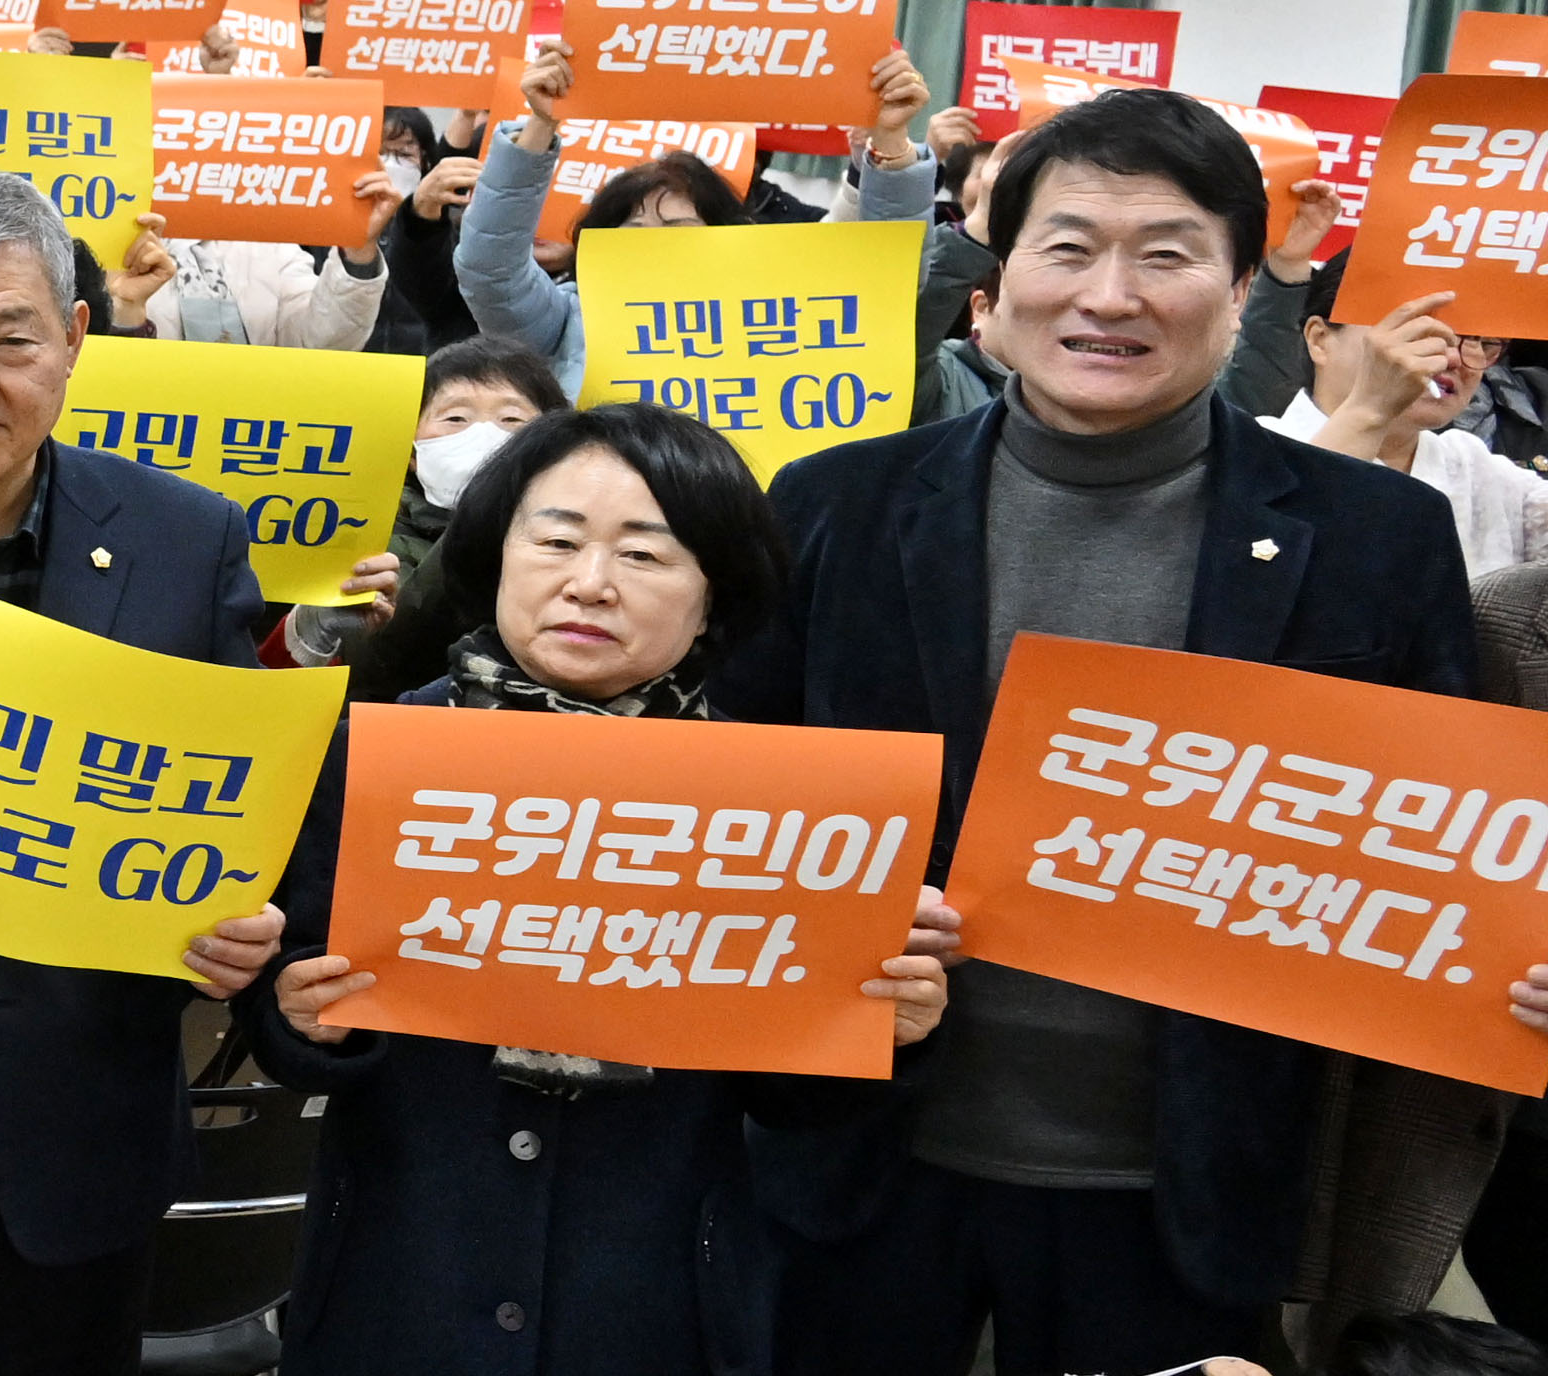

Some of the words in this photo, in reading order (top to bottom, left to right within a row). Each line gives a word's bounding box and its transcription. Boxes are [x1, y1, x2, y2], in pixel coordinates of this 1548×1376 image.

[596, 23, 836, 80] 선택했다.
[24, 108, 119, 160] 말고
[152, 105, 373, 160] 군위군민이
[152, 164, 334, 210] 선택했다.
[622, 296, 724, 359] 고민
[741, 294, 867, 358] 말고
[779, 370, 895, 433] GO~
[219, 420, 355, 480] 말고
[74, 728, 252, 822] 말고
[1038, 701, 1548, 896] 군위군민이
[94, 835, 262, 911] GO~
[393, 785, 914, 900] 군위군민이
[1024, 810, 1478, 991] 선택했다.
[395, 893, 810, 995] 선택했다.
